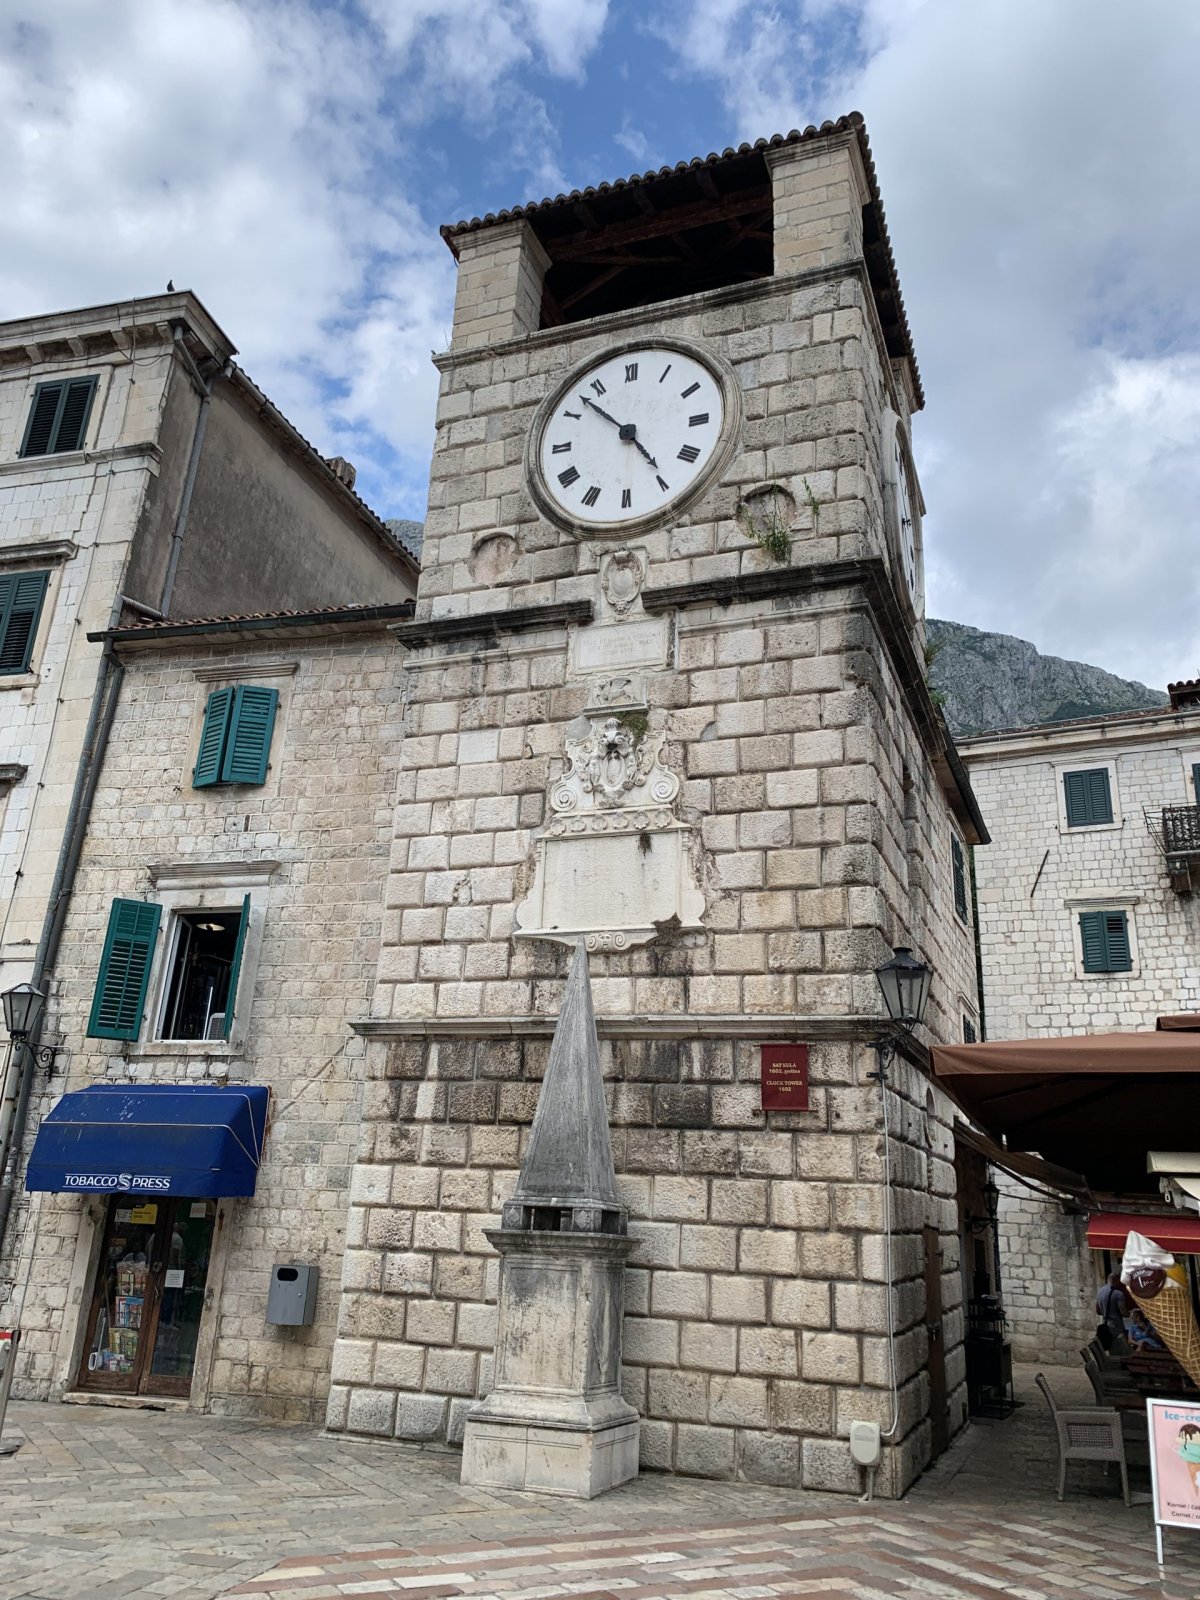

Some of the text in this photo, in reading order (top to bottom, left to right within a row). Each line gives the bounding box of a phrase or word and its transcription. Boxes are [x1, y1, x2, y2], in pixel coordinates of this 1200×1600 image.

[625, 362, 638, 384] XII
[590, 378, 607, 397] XI
[680, 381, 701, 399] II
[563, 410, 582, 421] X
[688, 412, 709, 427] III
[552, 441, 572, 454] IX
[676, 444, 701, 464] IIII
[557, 465, 581, 489] VIII
[656, 474, 670, 492] V
[581, 485, 602, 507] VII
[621, 488, 631, 509] VI
[64, 1175, 118, 1187] TOBACCO
[132, 1177, 171, 1189] PRESS
[1166, 1501, 1187, 1509] Kornet
